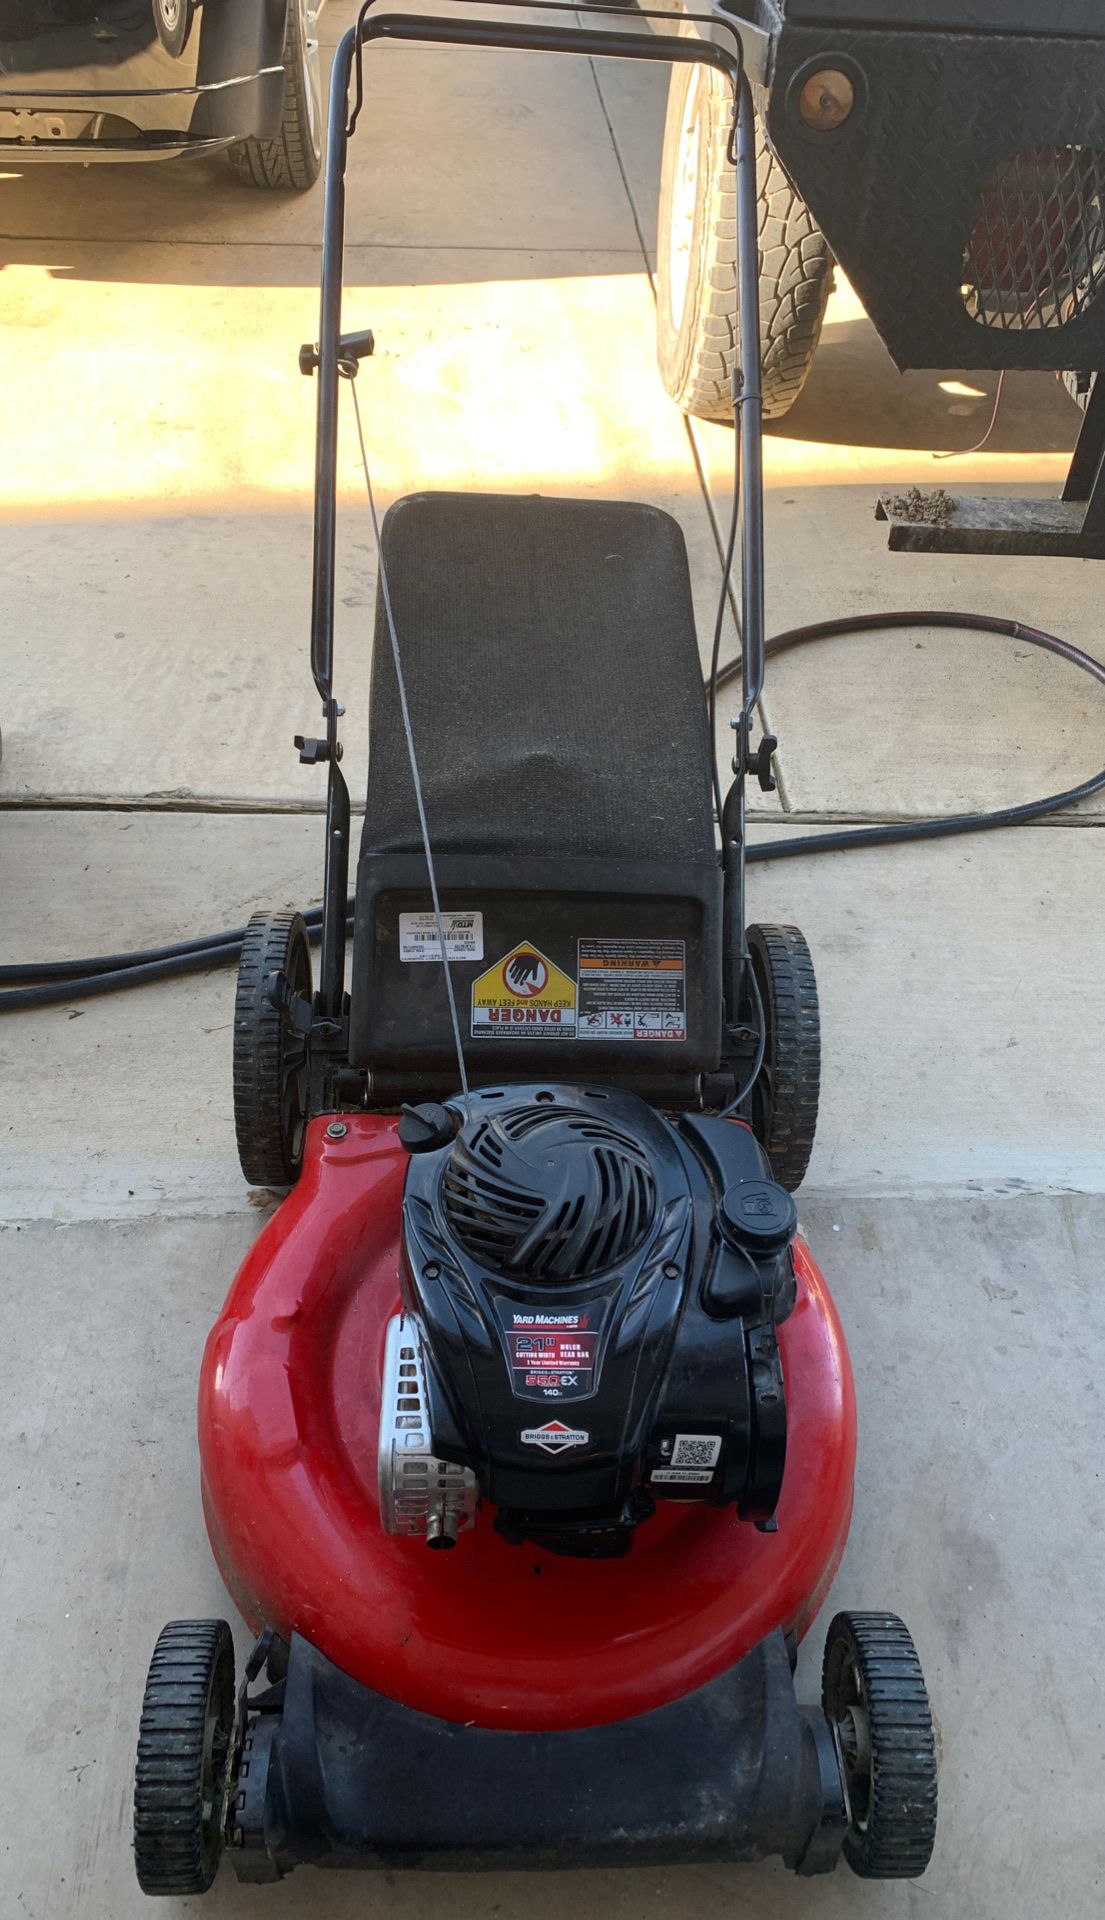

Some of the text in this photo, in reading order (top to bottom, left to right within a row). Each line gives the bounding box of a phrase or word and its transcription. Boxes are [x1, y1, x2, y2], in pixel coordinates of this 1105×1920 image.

[529, 999, 552, 1008] HANDS
[554, 999, 571, 1008] KEEP
[488, 1008, 562, 1022] DANGER
[513, 1314, 578, 1324] YARD MACHINES
[516, 1337, 555, 1352] 21"
